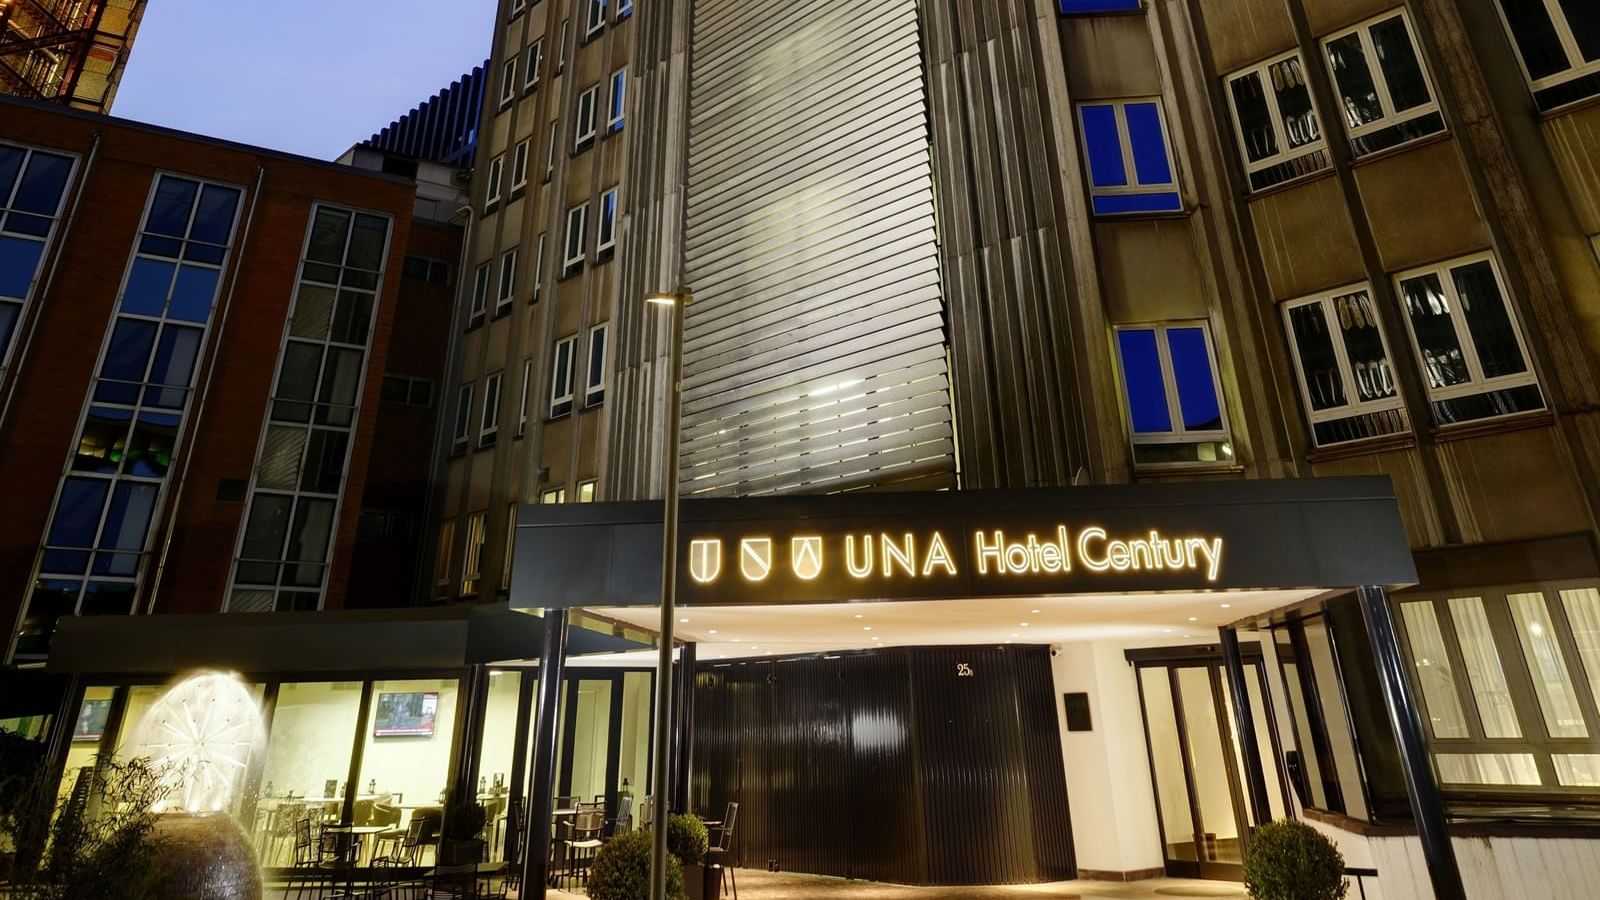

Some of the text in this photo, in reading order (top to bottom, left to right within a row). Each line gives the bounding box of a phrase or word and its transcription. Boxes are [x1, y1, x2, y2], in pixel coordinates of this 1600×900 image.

[845, 525, 1222, 581] UNA Hotel Century
